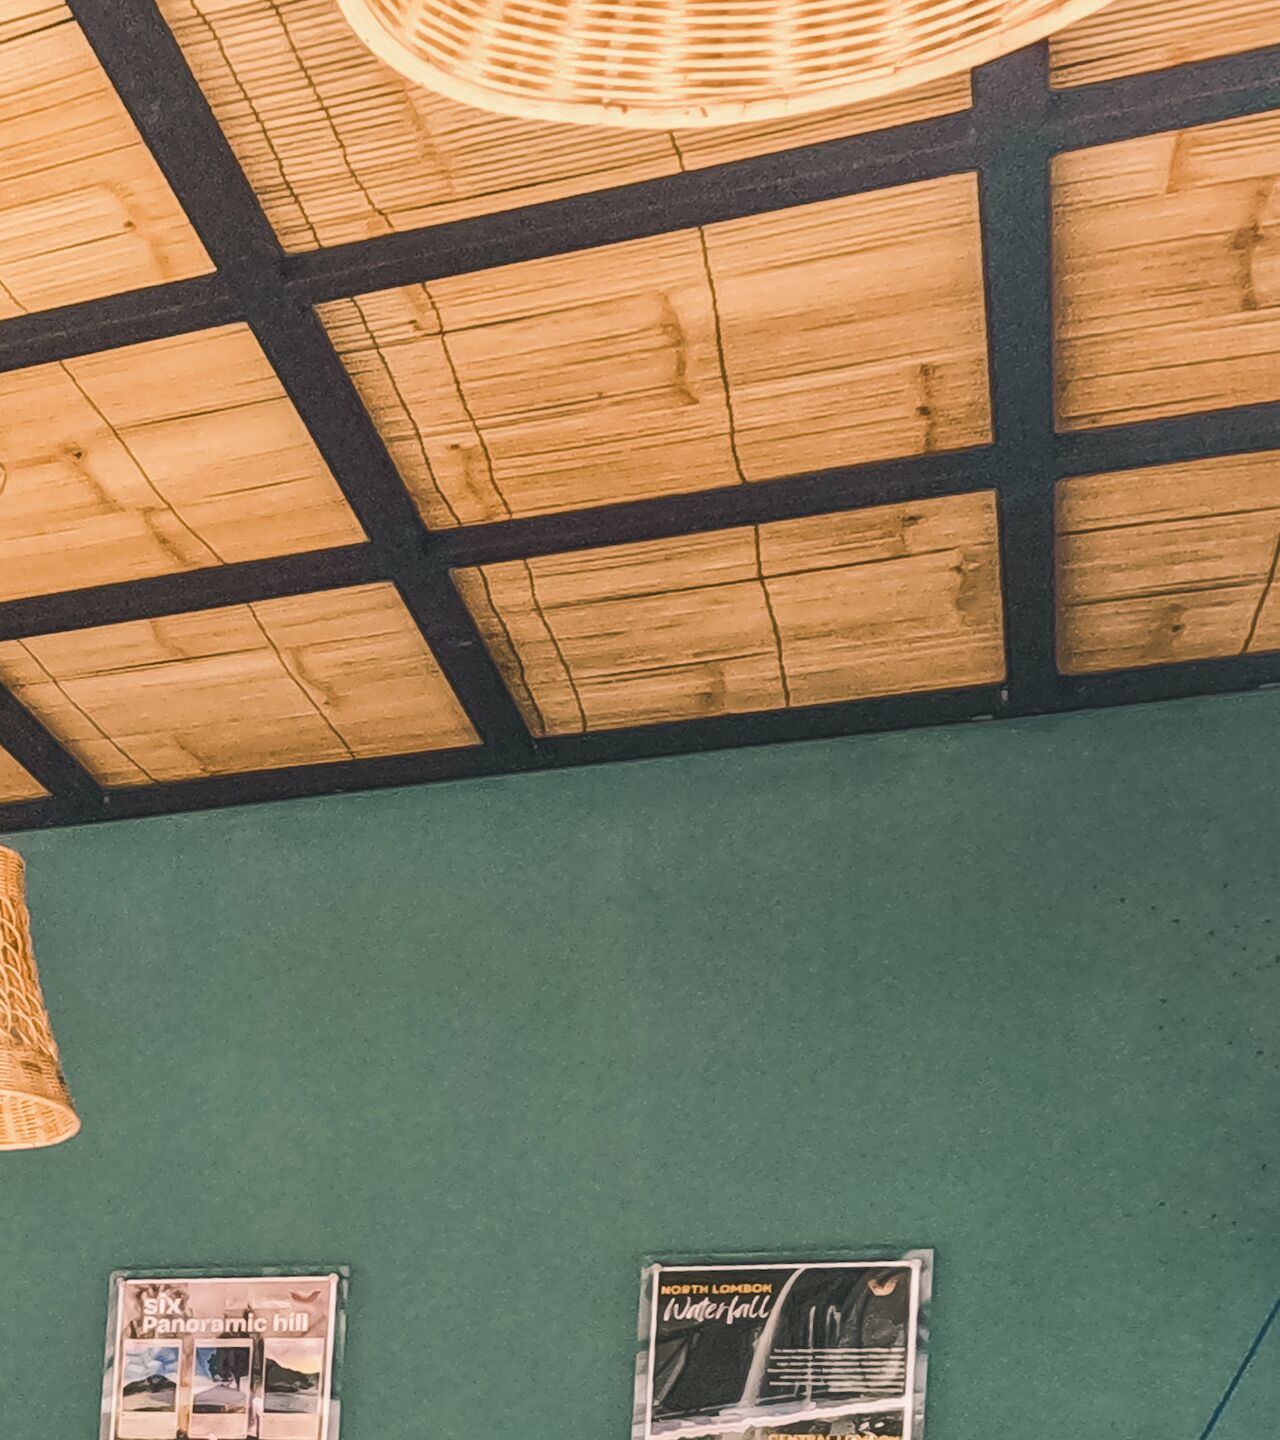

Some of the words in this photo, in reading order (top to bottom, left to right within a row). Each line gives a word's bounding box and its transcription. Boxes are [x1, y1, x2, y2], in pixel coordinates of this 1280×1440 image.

[660, 1285, 709, 1295] NORTH
[711, 1283, 773, 1295] LOMBOK
[143, 1291, 183, 1314] six
[663, 1295, 773, 1325] Waterfall
[142, 1312, 268, 1334] Panoramic
[273, 1312, 309, 1332] hill
